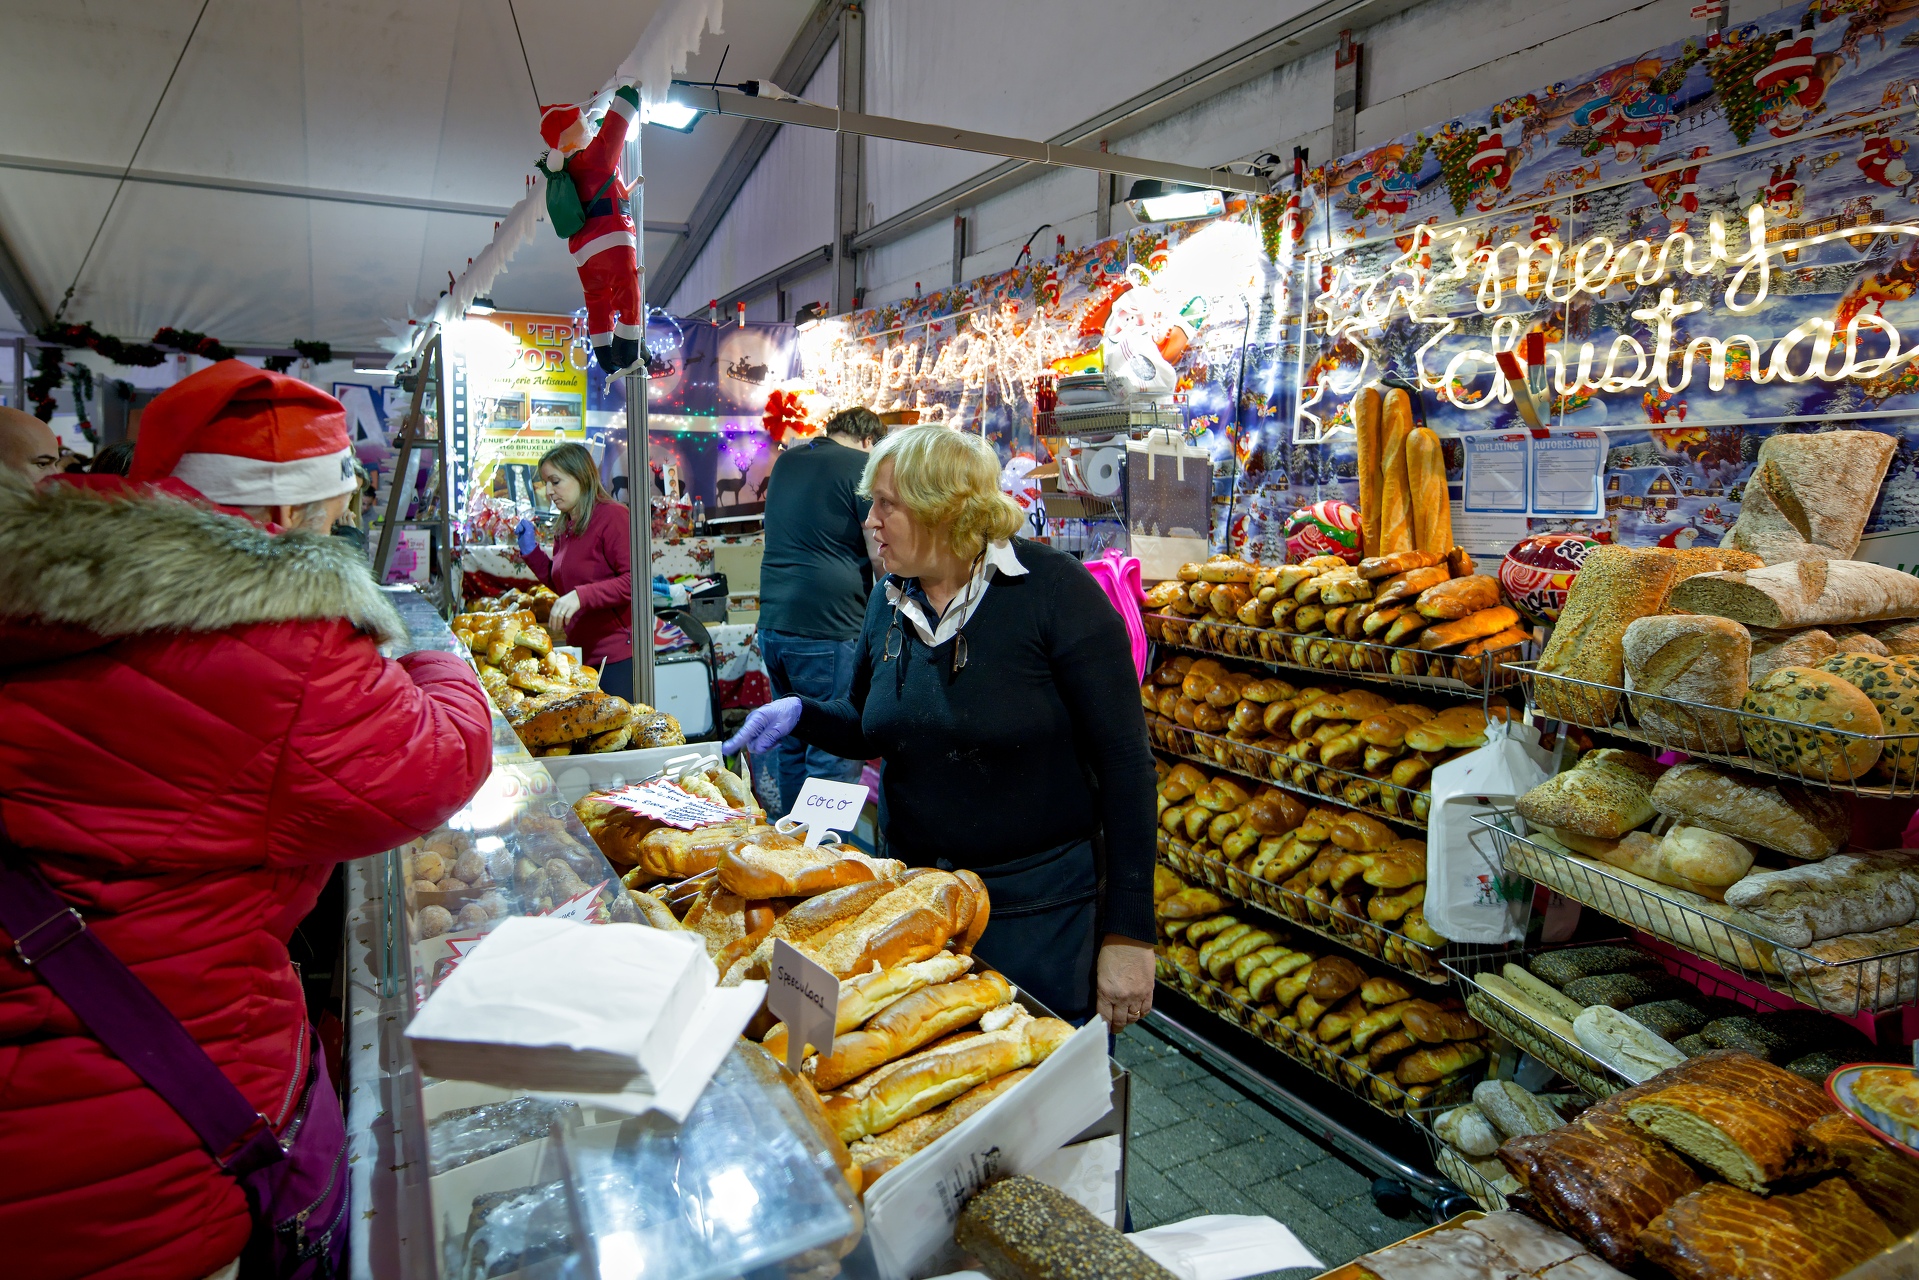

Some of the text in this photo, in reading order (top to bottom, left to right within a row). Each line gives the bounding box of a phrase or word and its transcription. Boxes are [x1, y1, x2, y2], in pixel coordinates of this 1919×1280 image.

[533, 376, 578, 387] Artisanale
[1475, 442, 1519, 452] TOELATING
[1534, 440, 1600, 450] AUTORISATION
